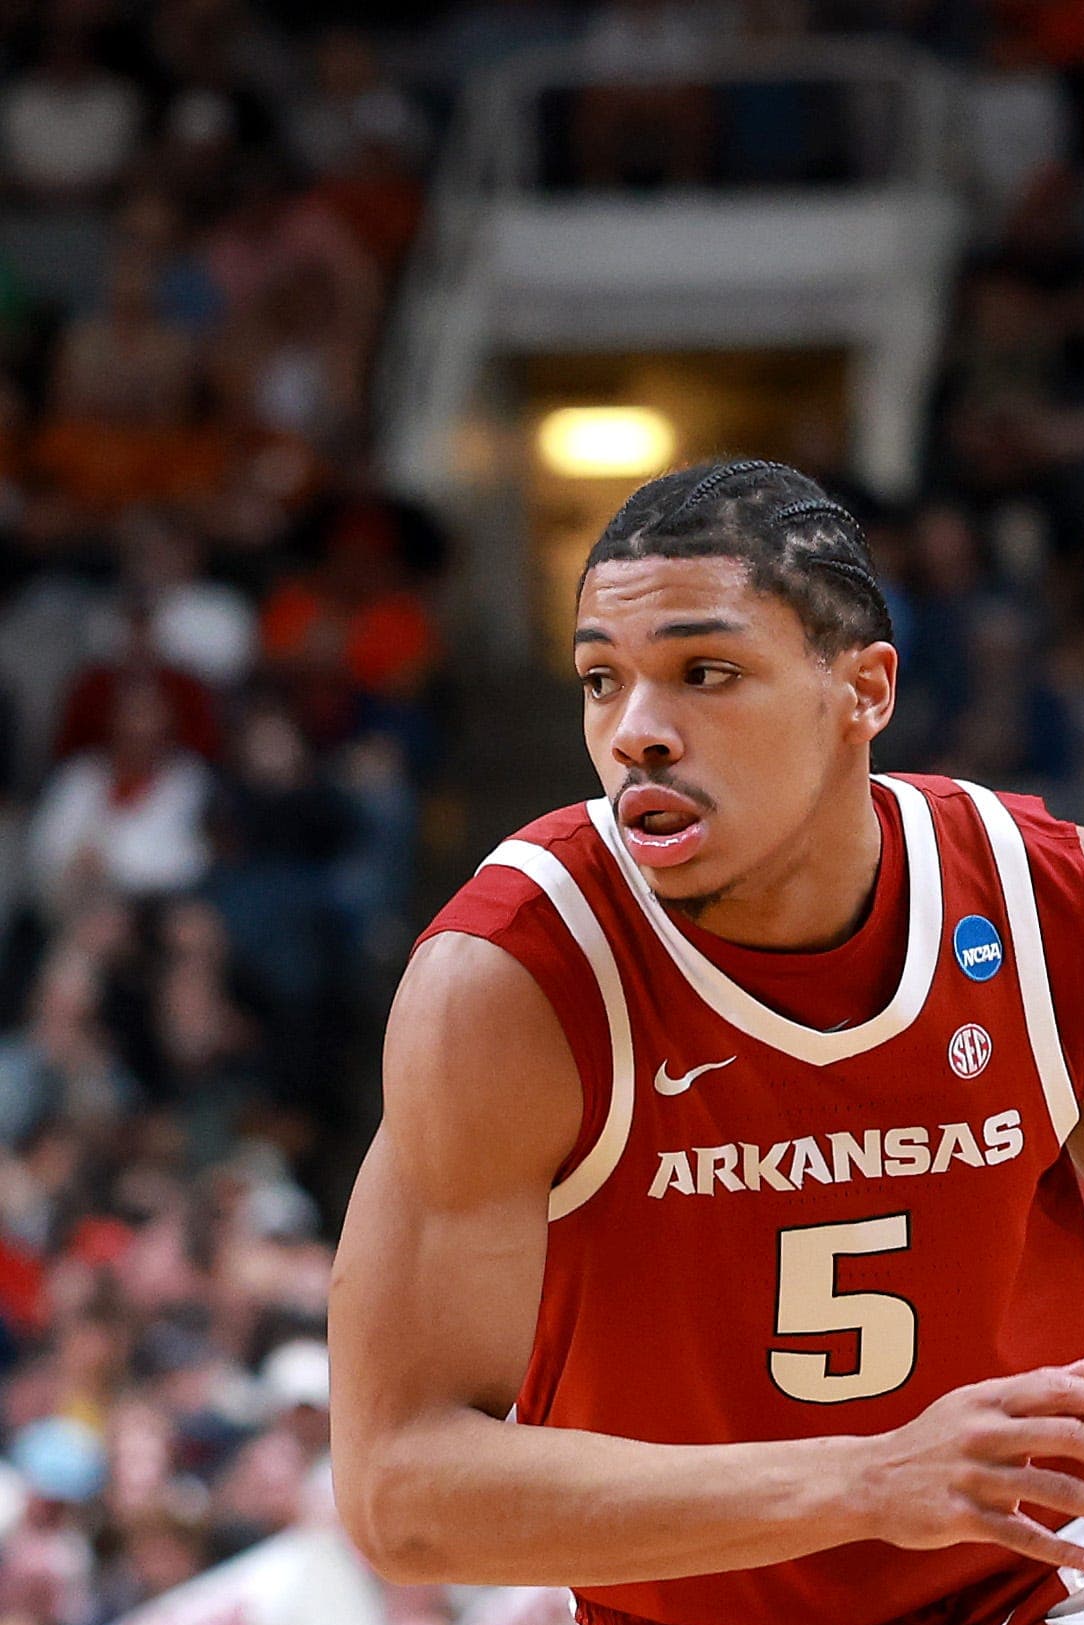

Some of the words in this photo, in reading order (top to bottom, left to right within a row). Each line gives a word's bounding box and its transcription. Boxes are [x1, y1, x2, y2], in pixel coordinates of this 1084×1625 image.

[962, 942, 1001, 967] NCAA
[952, 1027, 989, 1074] SEC
[648, 1109, 1024, 1199] ARKANSAS
[767, 1211, 918, 1404] 5
